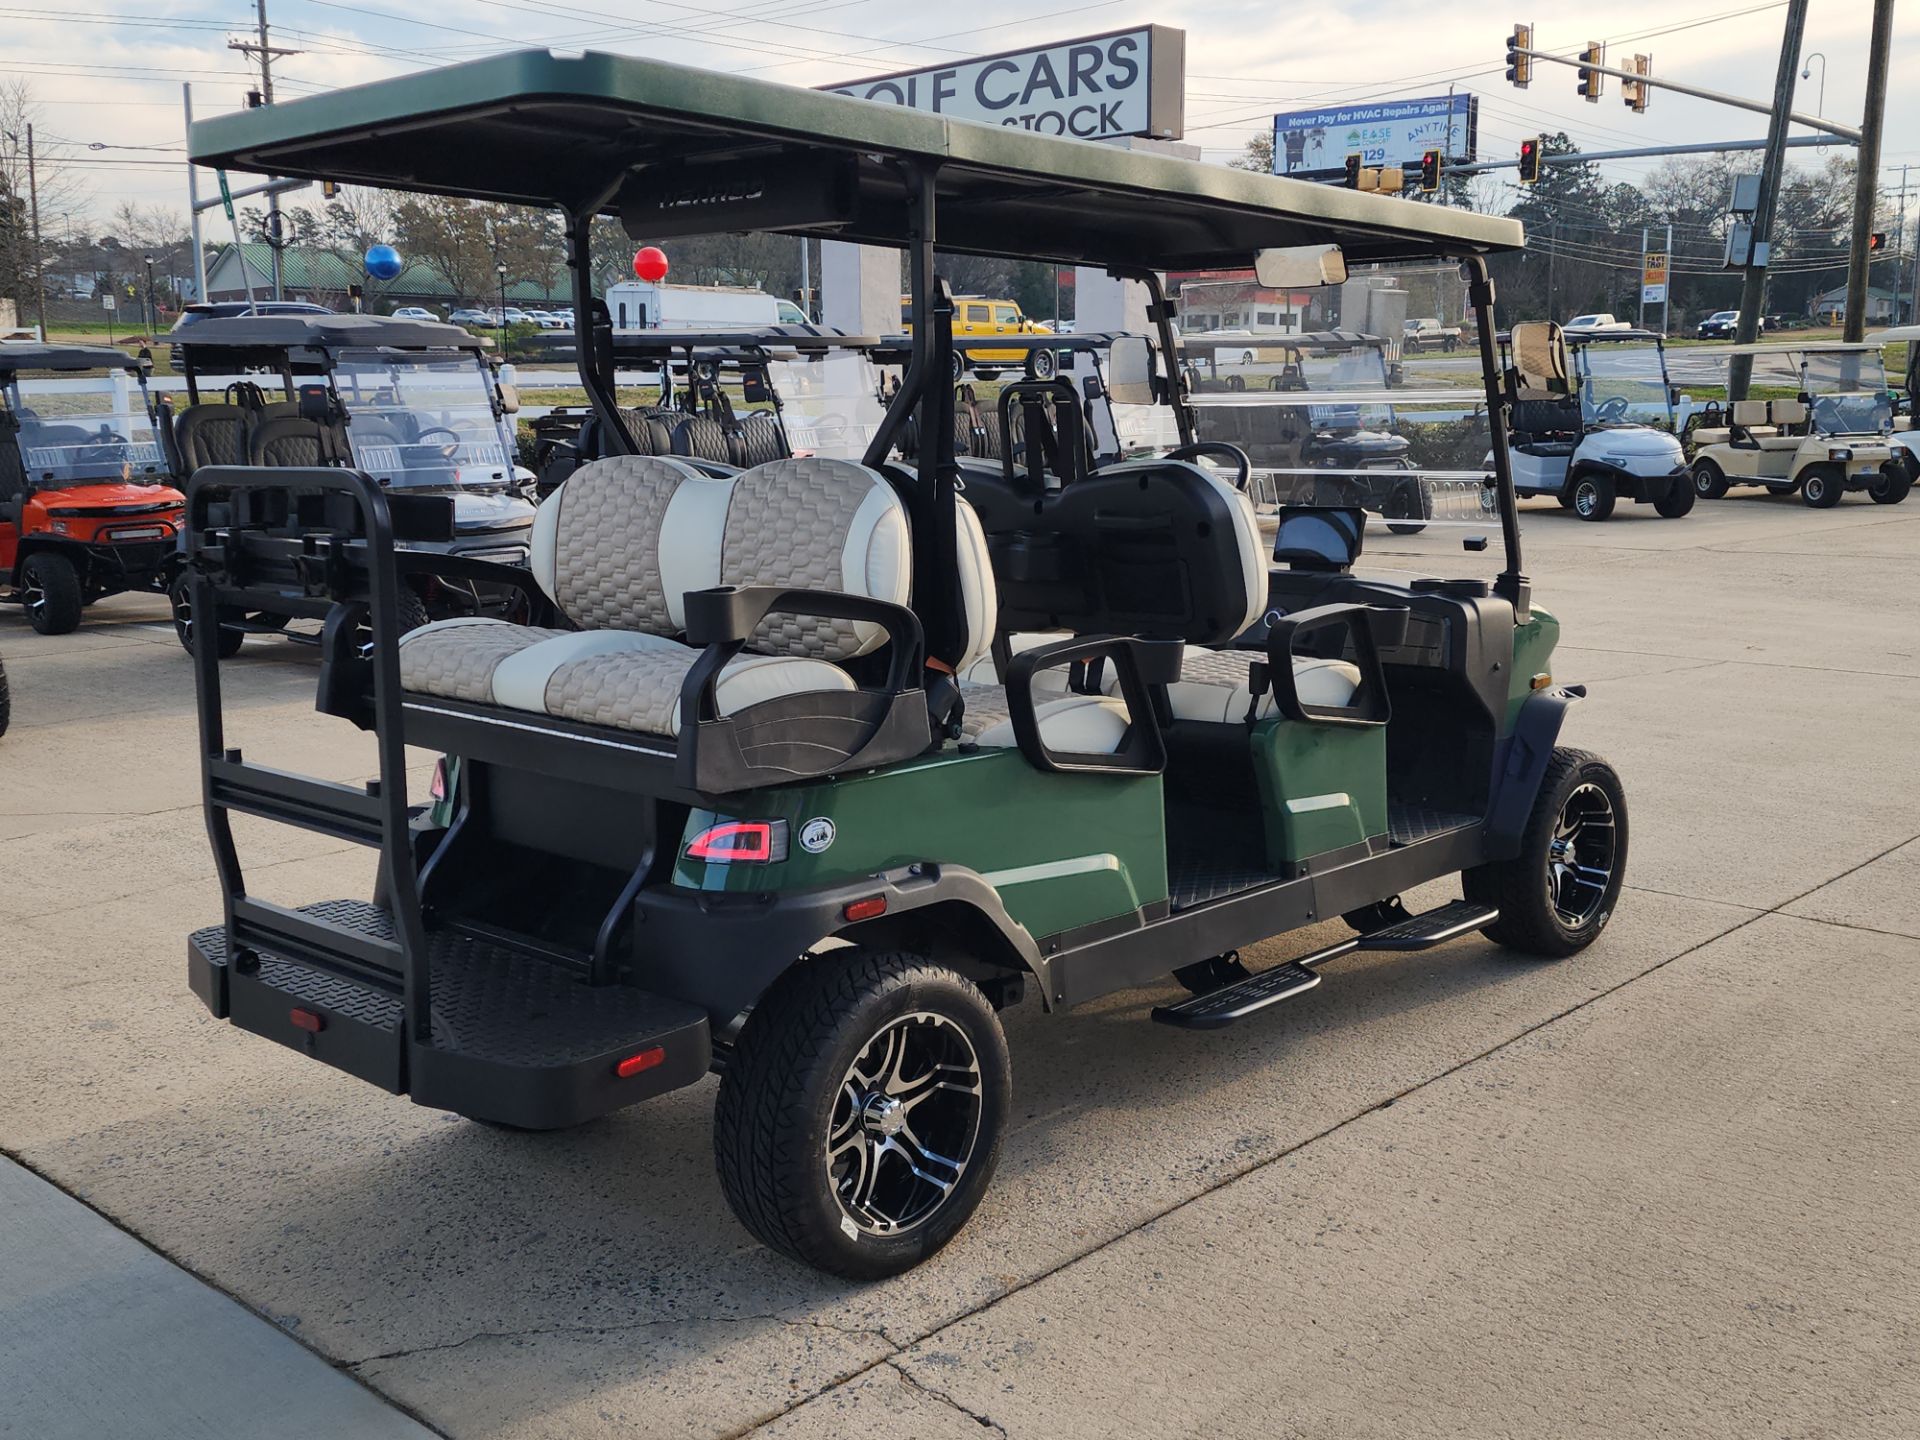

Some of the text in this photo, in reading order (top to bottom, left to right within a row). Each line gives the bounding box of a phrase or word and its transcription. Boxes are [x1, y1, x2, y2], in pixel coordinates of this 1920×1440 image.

[974, 37, 1139, 110] CARS
[1288, 117, 1317, 127] Never
[1317, 114, 1336, 125] Pay
[1337, 111, 1352, 122] for
[1353, 109, 1381, 120] HVAC
[1382, 104, 1420, 118] Repairs
